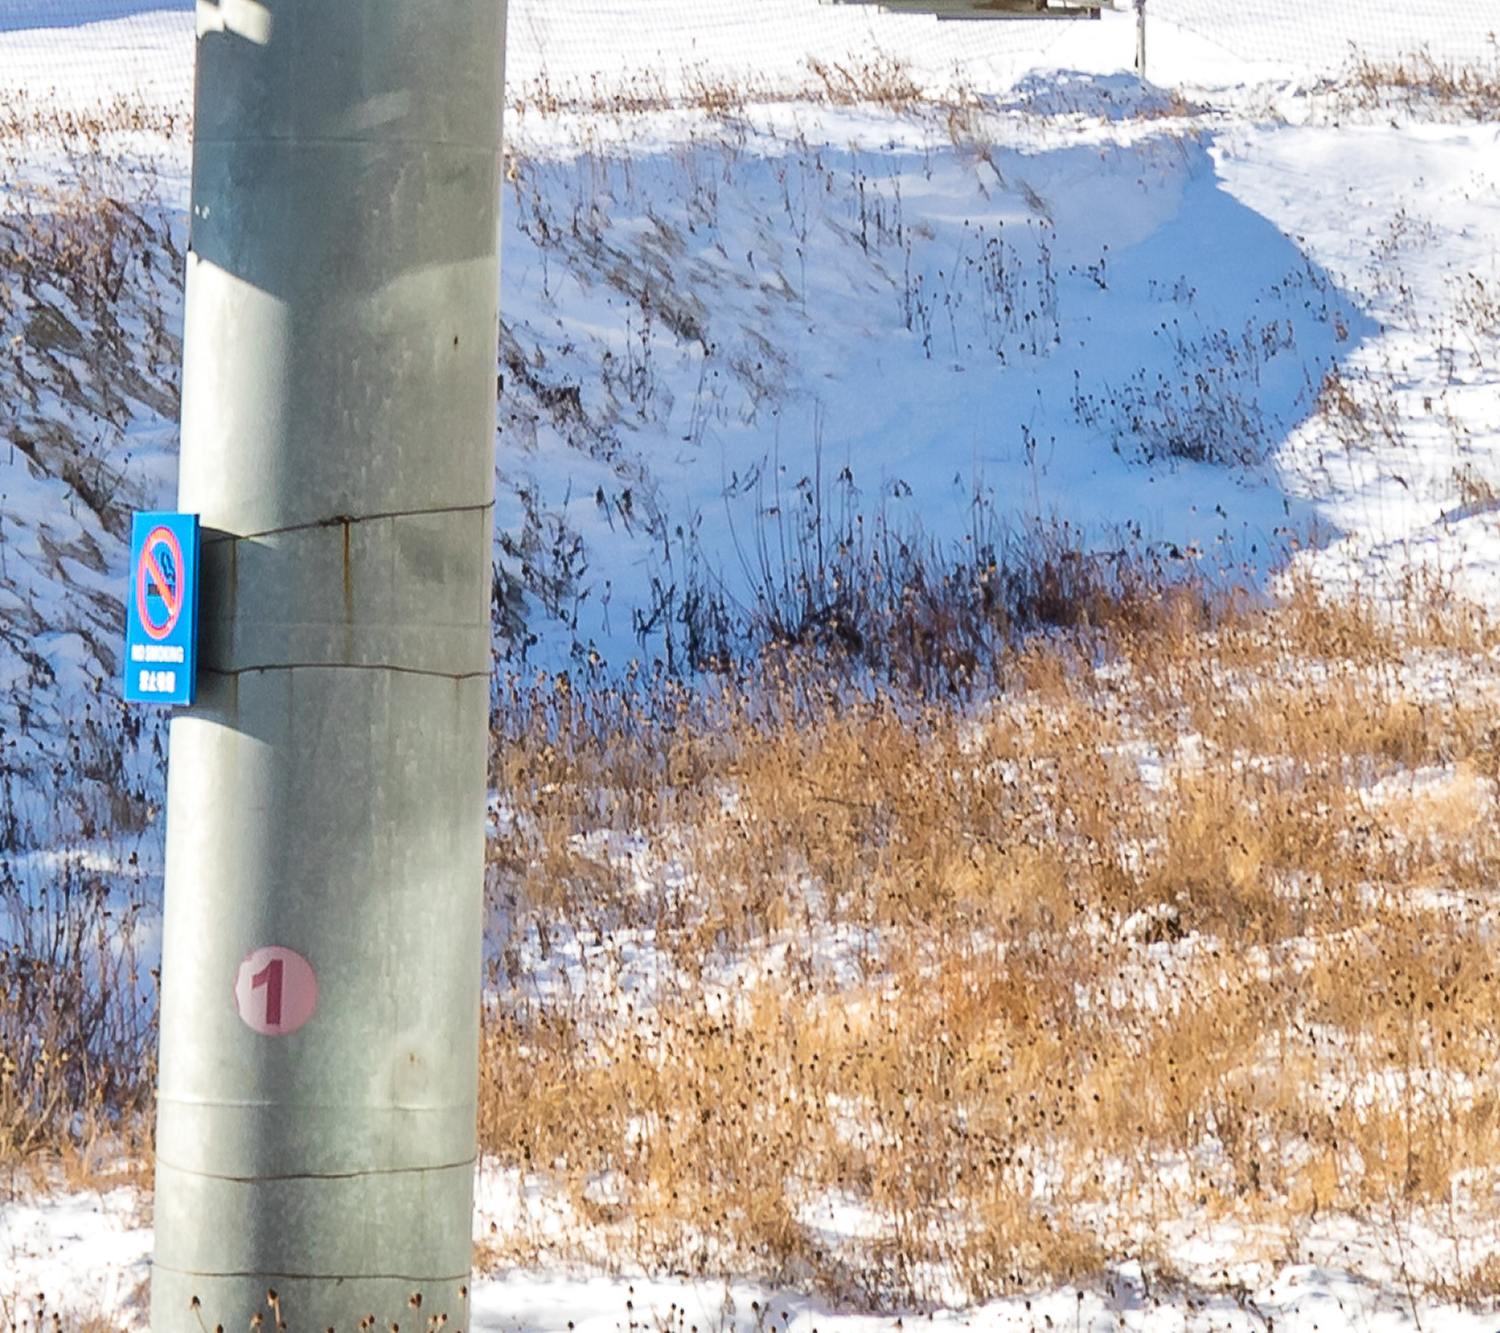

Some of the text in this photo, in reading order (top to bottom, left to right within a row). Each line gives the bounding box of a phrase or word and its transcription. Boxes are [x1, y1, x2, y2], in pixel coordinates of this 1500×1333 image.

[132, 644, 184, 663] NO SMOKING
[252, 958, 283, 1025] 1
